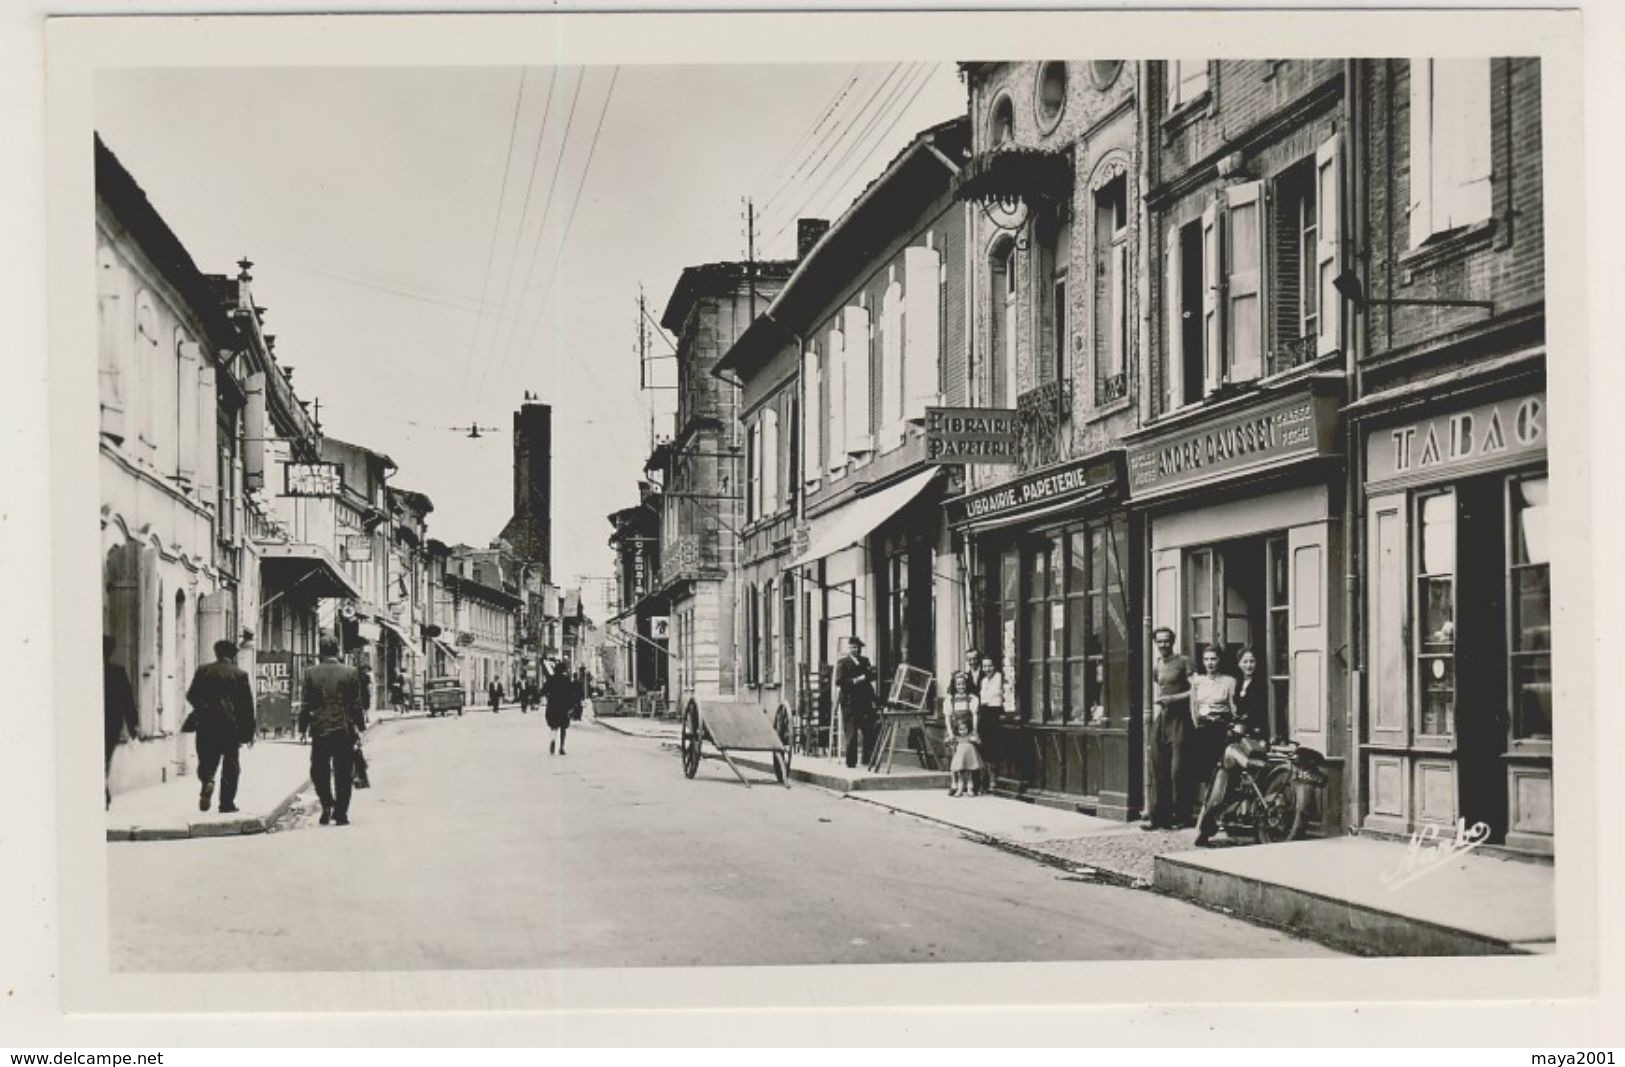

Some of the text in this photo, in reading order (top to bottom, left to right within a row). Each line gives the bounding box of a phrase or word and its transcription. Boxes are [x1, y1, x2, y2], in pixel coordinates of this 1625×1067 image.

[928, 410, 1018, 433] LIBRAIRIE
[1391, 396, 1543, 473] TABAC
[928, 436, 1018, 460] PAPETERIE
[1023, 468, 1087, 502] PAPETERIE
